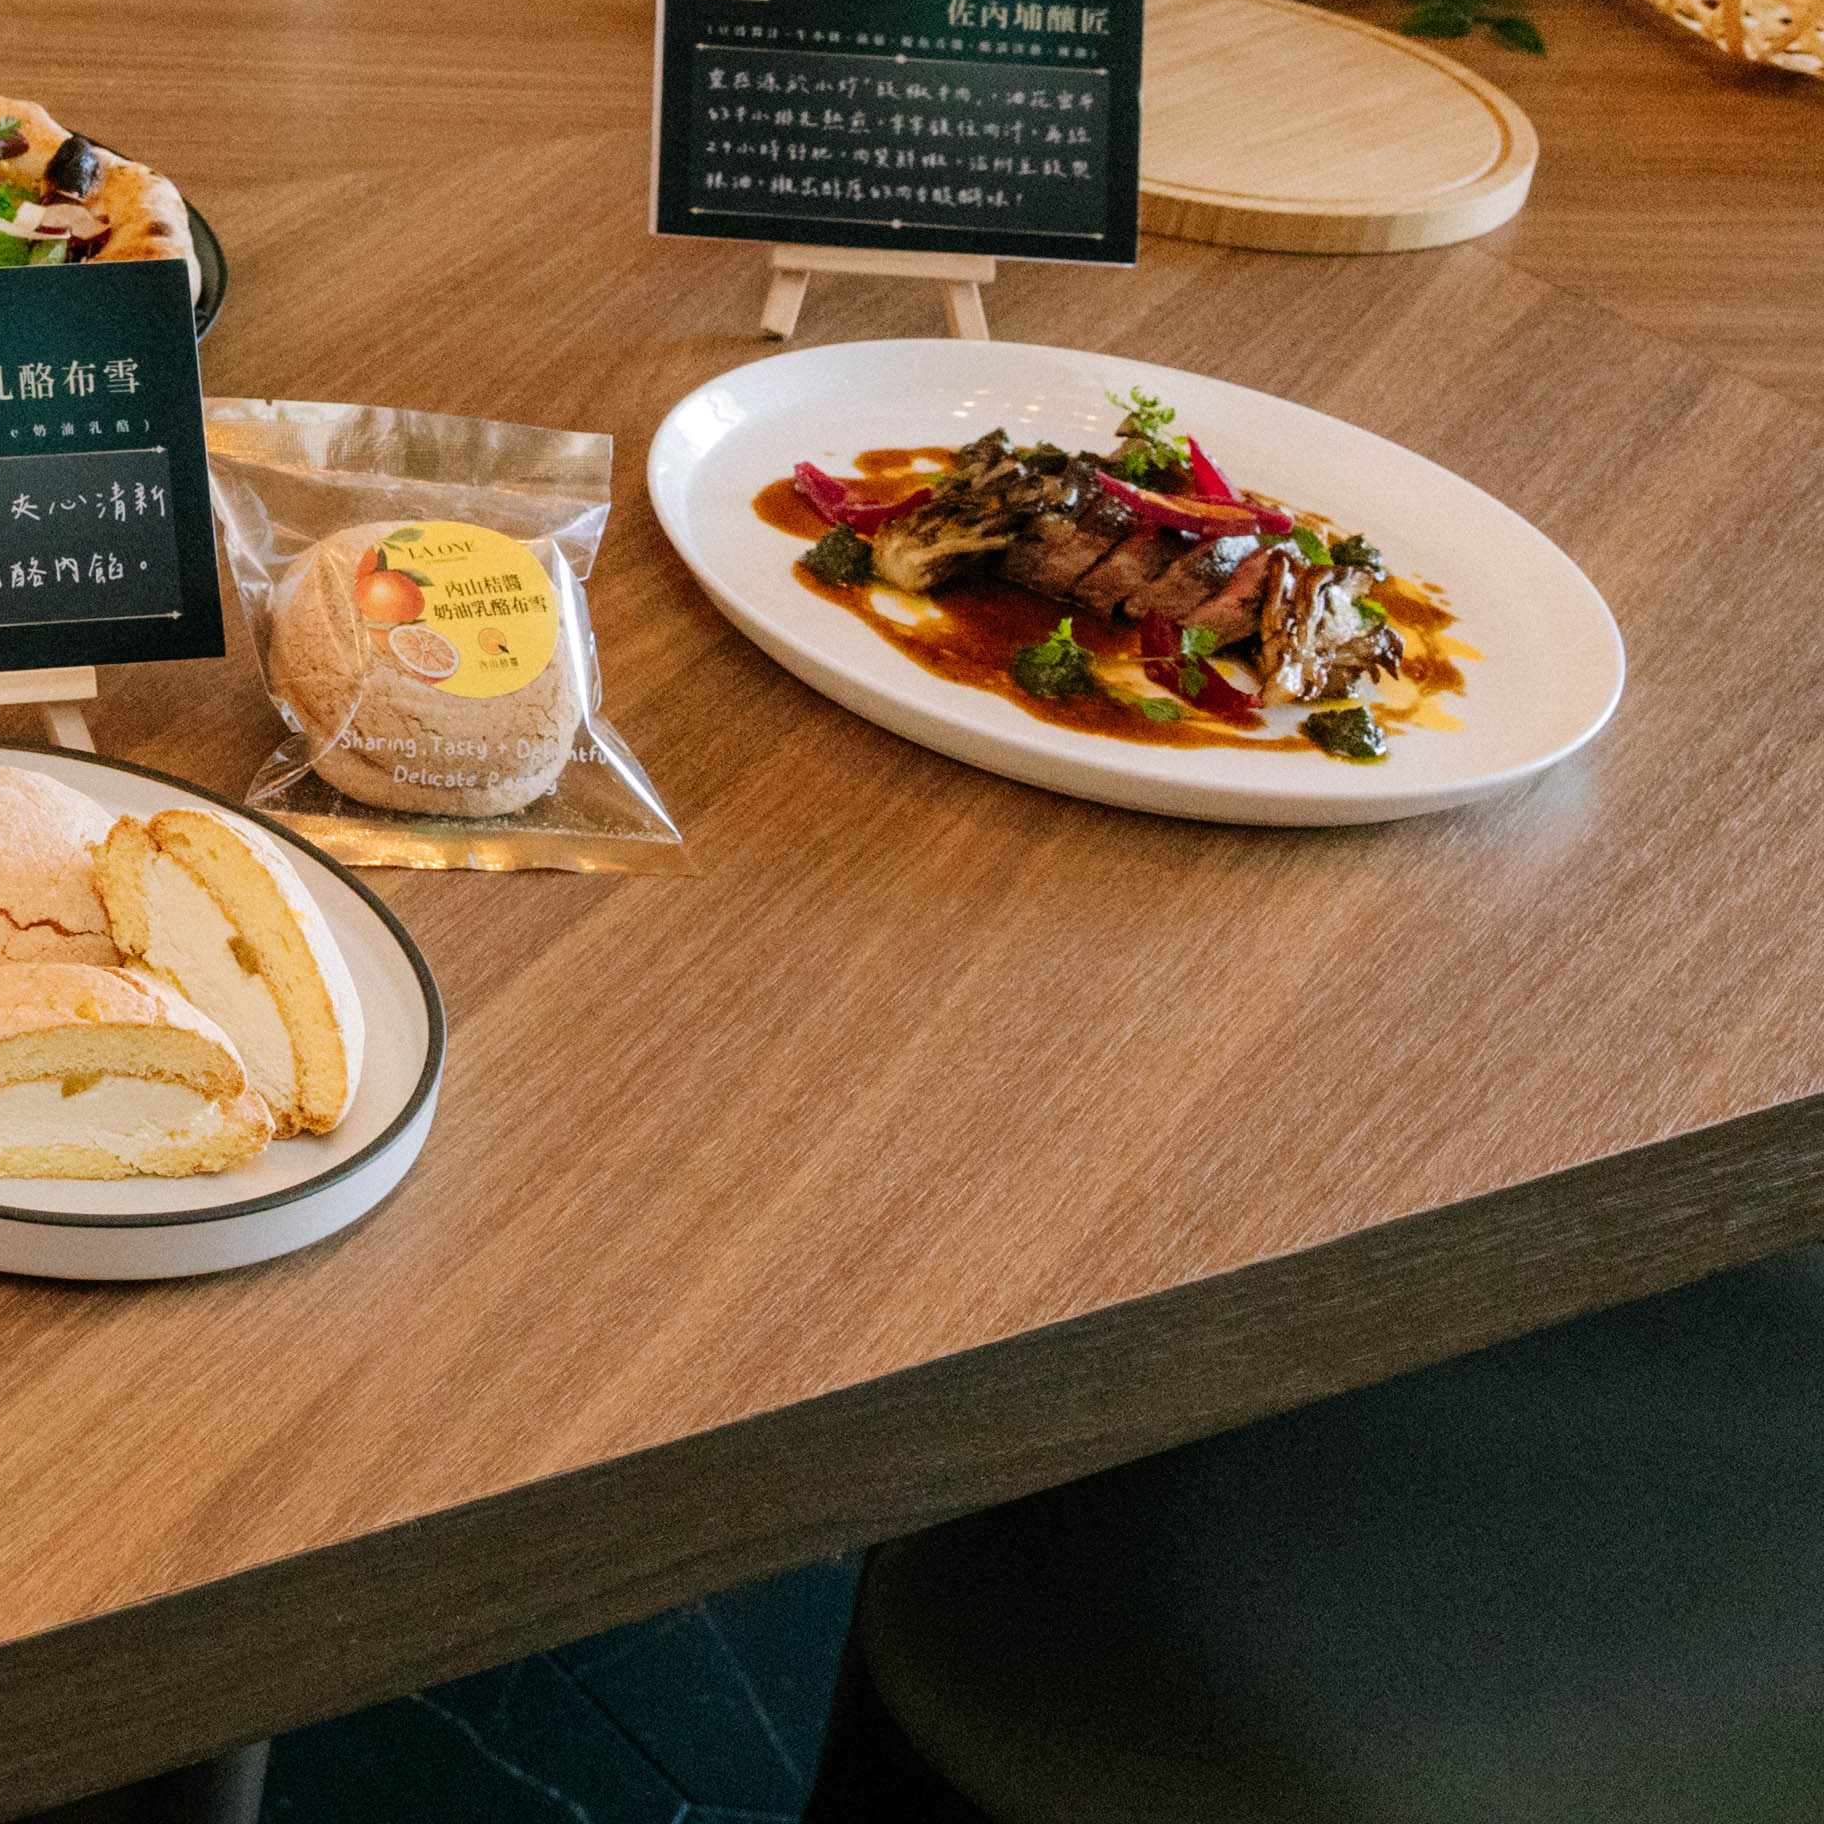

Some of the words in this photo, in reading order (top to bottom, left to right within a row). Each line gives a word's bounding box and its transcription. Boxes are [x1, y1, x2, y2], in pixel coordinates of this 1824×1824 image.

[445, 575, 523, 598] 內山桔醬
[434, 595, 549, 621] 奶油乳酪布雪
[432, 736, 488, 759] Tasty
[393, 765, 477, 787] Delicate
